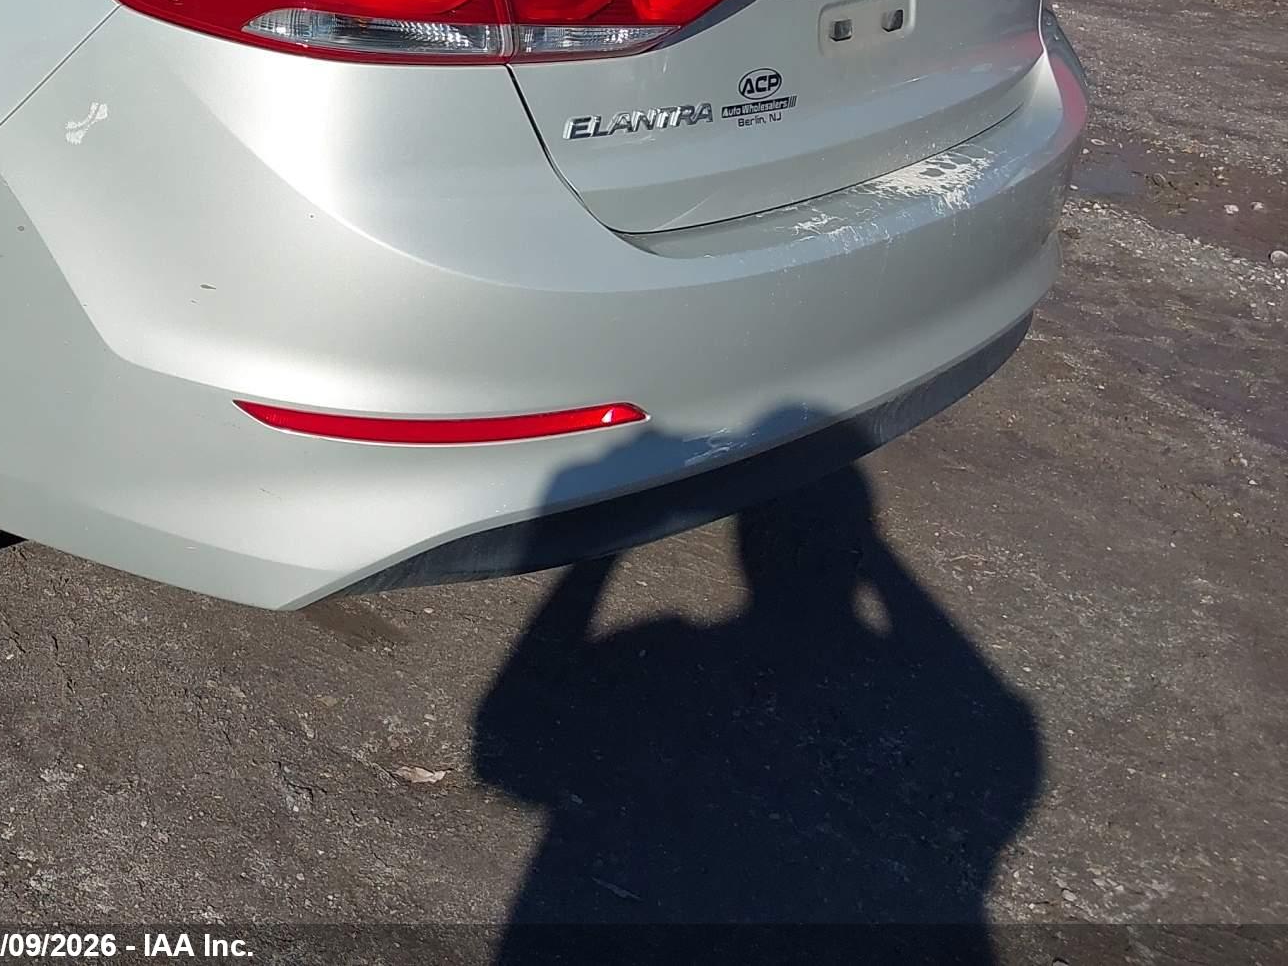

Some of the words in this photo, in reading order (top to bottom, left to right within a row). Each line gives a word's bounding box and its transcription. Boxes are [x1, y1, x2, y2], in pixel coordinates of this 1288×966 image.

[741, 73, 780, 95] ACP
[723, 105, 741, 118] Auto
[769, 112, 782, 123] NJ
[562, 102, 713, 140] ELANTRA
